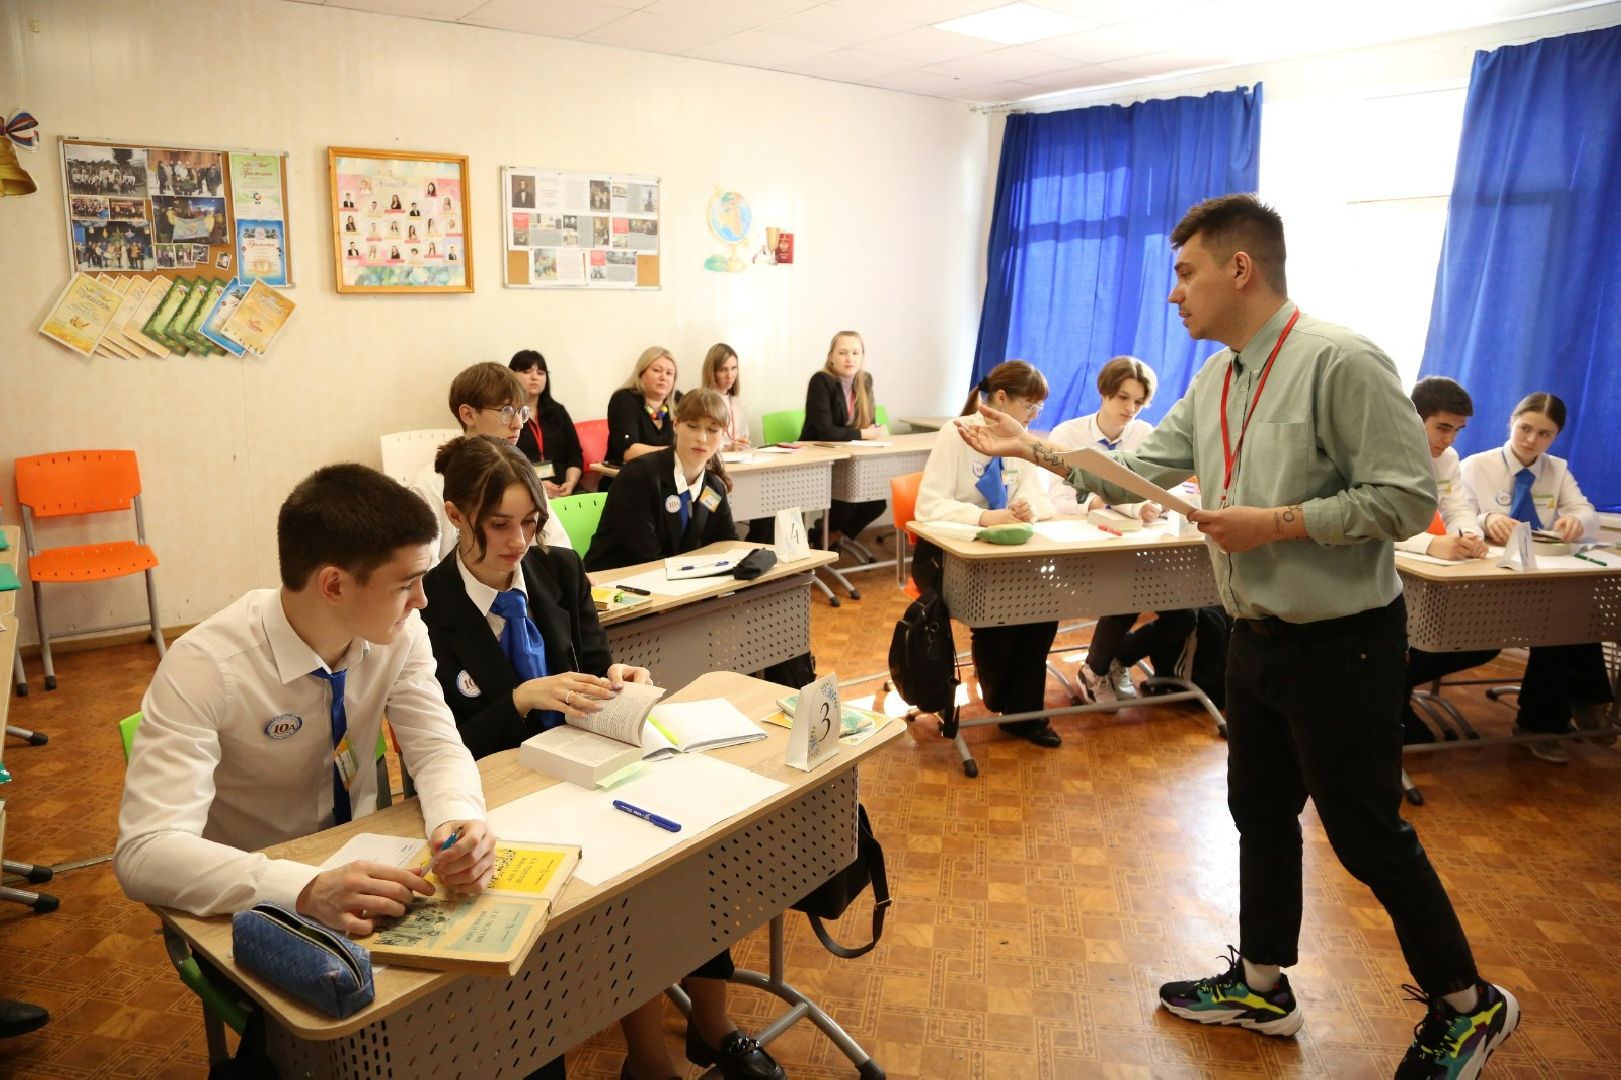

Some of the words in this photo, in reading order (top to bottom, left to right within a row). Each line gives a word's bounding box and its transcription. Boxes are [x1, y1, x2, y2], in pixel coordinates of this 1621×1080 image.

[791, 521, 800, 545] 4
[272, 723, 297, 735] 10А
[818, 702, 831, 743] 3
